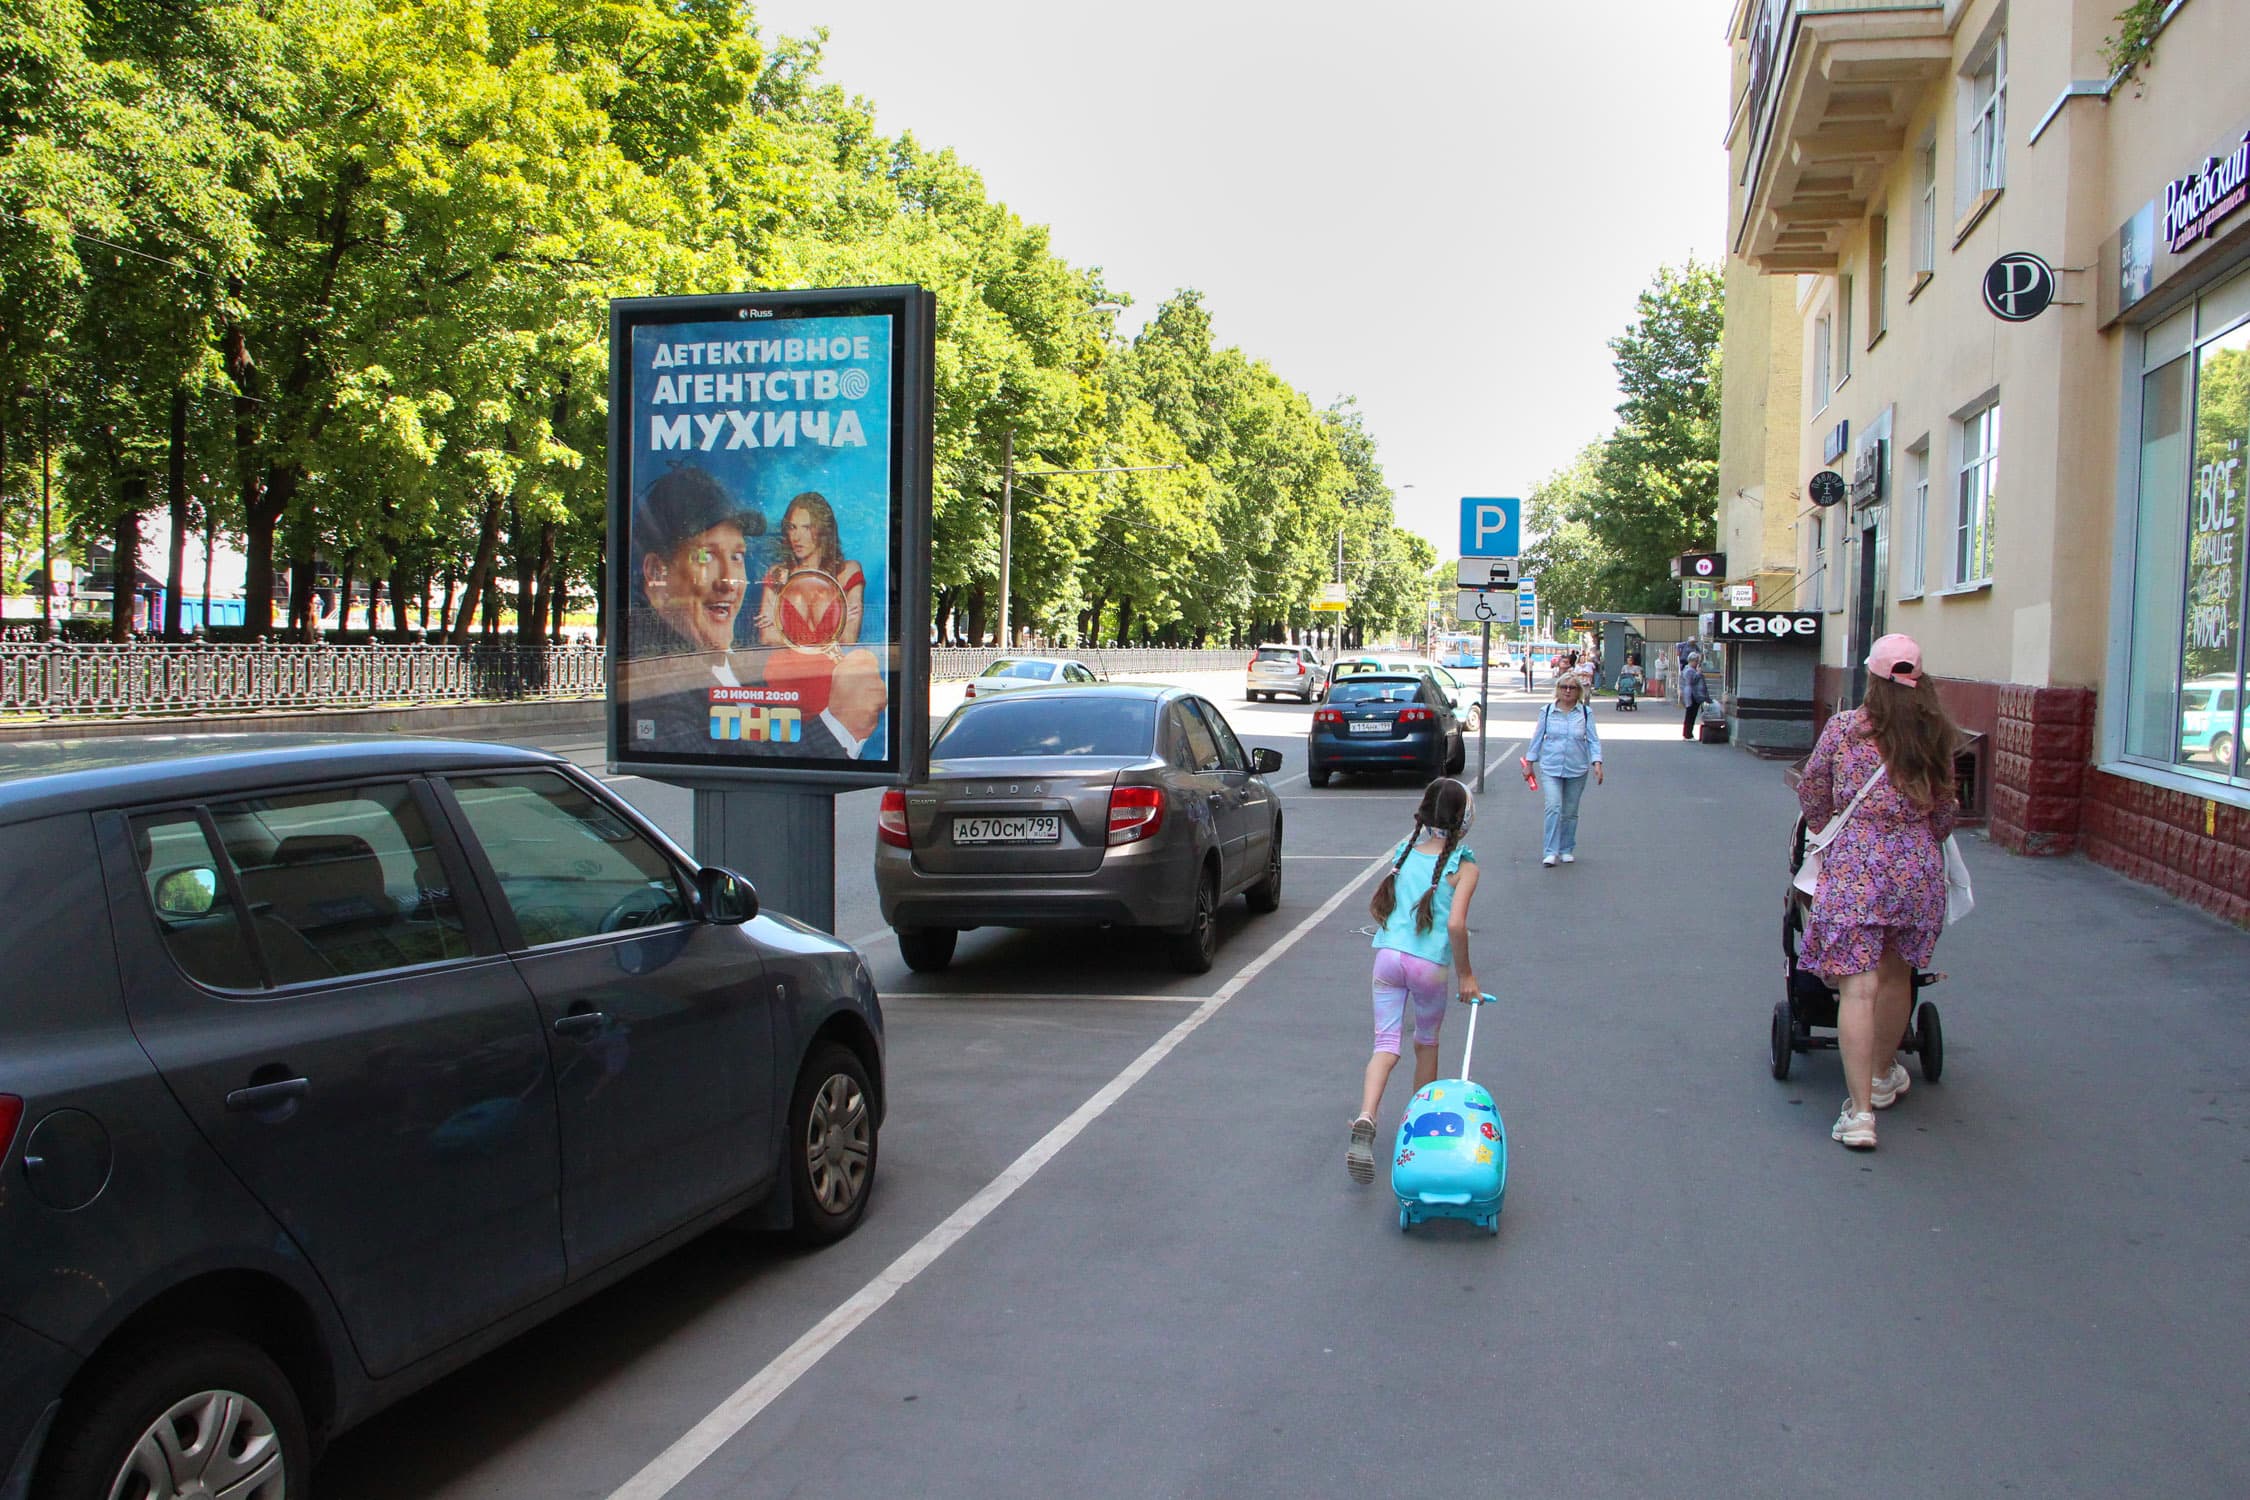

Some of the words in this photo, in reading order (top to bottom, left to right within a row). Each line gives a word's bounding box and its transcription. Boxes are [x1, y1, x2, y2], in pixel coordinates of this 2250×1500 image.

[750, 309, 773, 318] Russ
[651, 336, 870, 369] ДЕТЕКТИВНОЕ
[651, 367, 870, 405] АГЕНТСТВО
[651, 409, 868, 452] МУХИЧА
[1475, 505, 1507, 549] P
[713, 689, 728, 699] 20
[730, 690, 764, 700] ИЮНЯ
[765, 691, 799, 701] 20:00
[710, 705, 801, 743] ТНТ
[965, 784, 1042, 795] LADA
